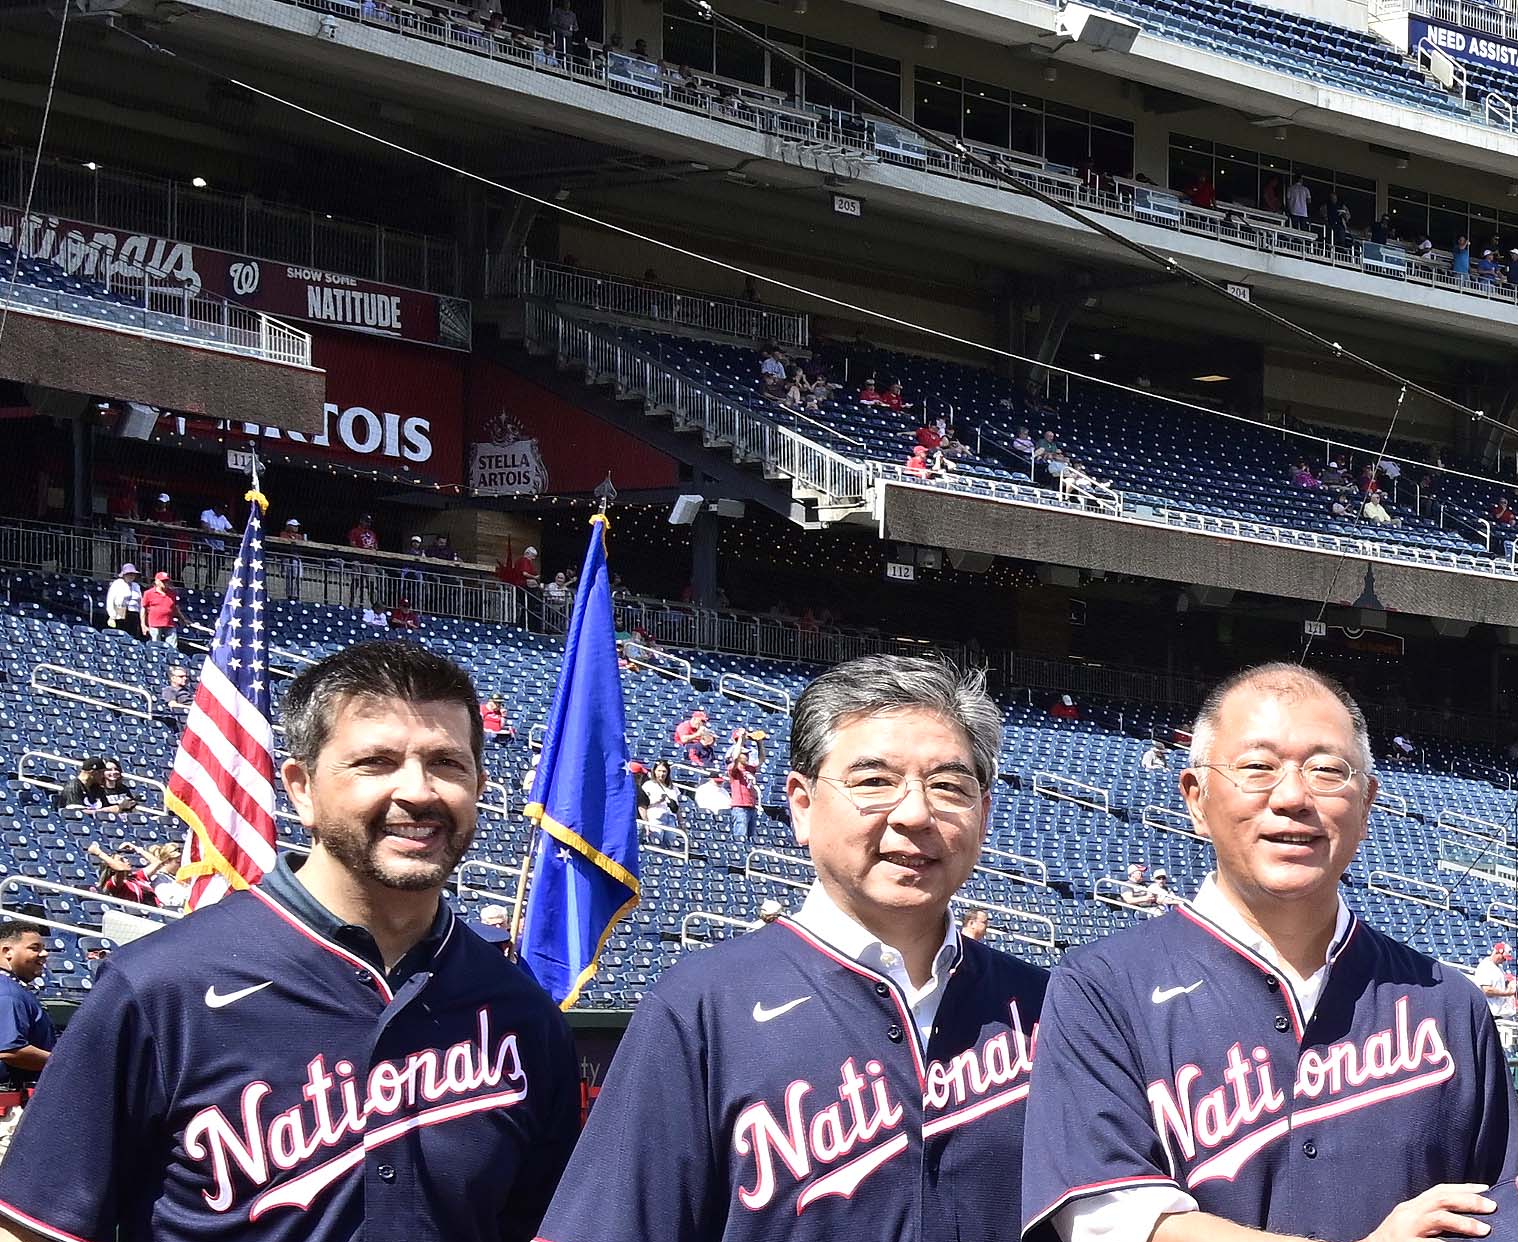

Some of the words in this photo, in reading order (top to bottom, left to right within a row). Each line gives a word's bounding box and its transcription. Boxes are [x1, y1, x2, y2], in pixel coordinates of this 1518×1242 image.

[1427, 25, 1466, 51] NEED
[839, 199, 856, 212] 205
[287, 267, 322, 282] SHOW
[325, 275, 358, 287] SOME
[307, 285, 402, 329] NATITUDE
[479, 453, 530, 470] STELLA
[478, 470, 531, 487] ARTOIS
[892, 566, 910, 577] 112
[1147, 996, 1455, 1190] Nationals
[184, 1006, 528, 1220] Nationals
[734, 997, 1040, 1214] National
